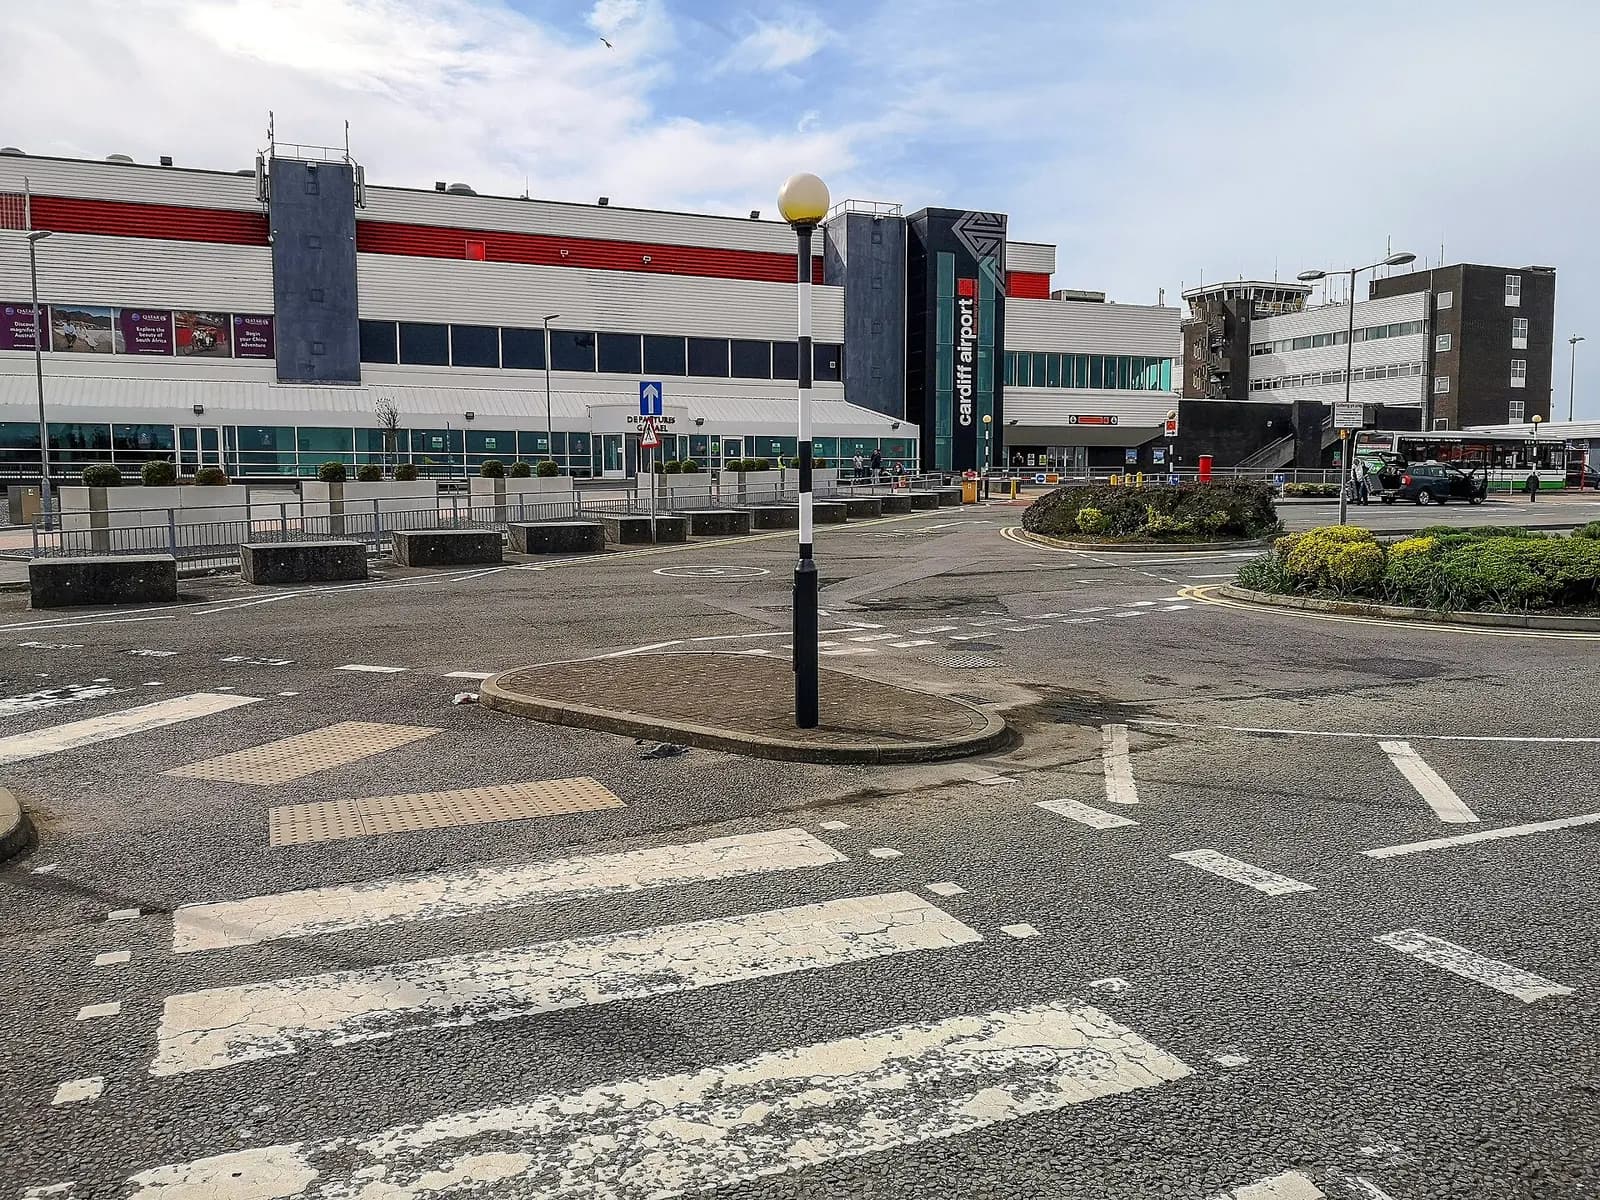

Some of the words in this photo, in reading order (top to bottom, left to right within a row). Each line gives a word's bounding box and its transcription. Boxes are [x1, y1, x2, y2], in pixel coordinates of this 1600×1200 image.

[957, 298, 977, 363] airport
[957, 364, 972, 426] cardiff
[627, 416, 676, 424] DEPATURES
[636, 424, 669, 432] GAEL
